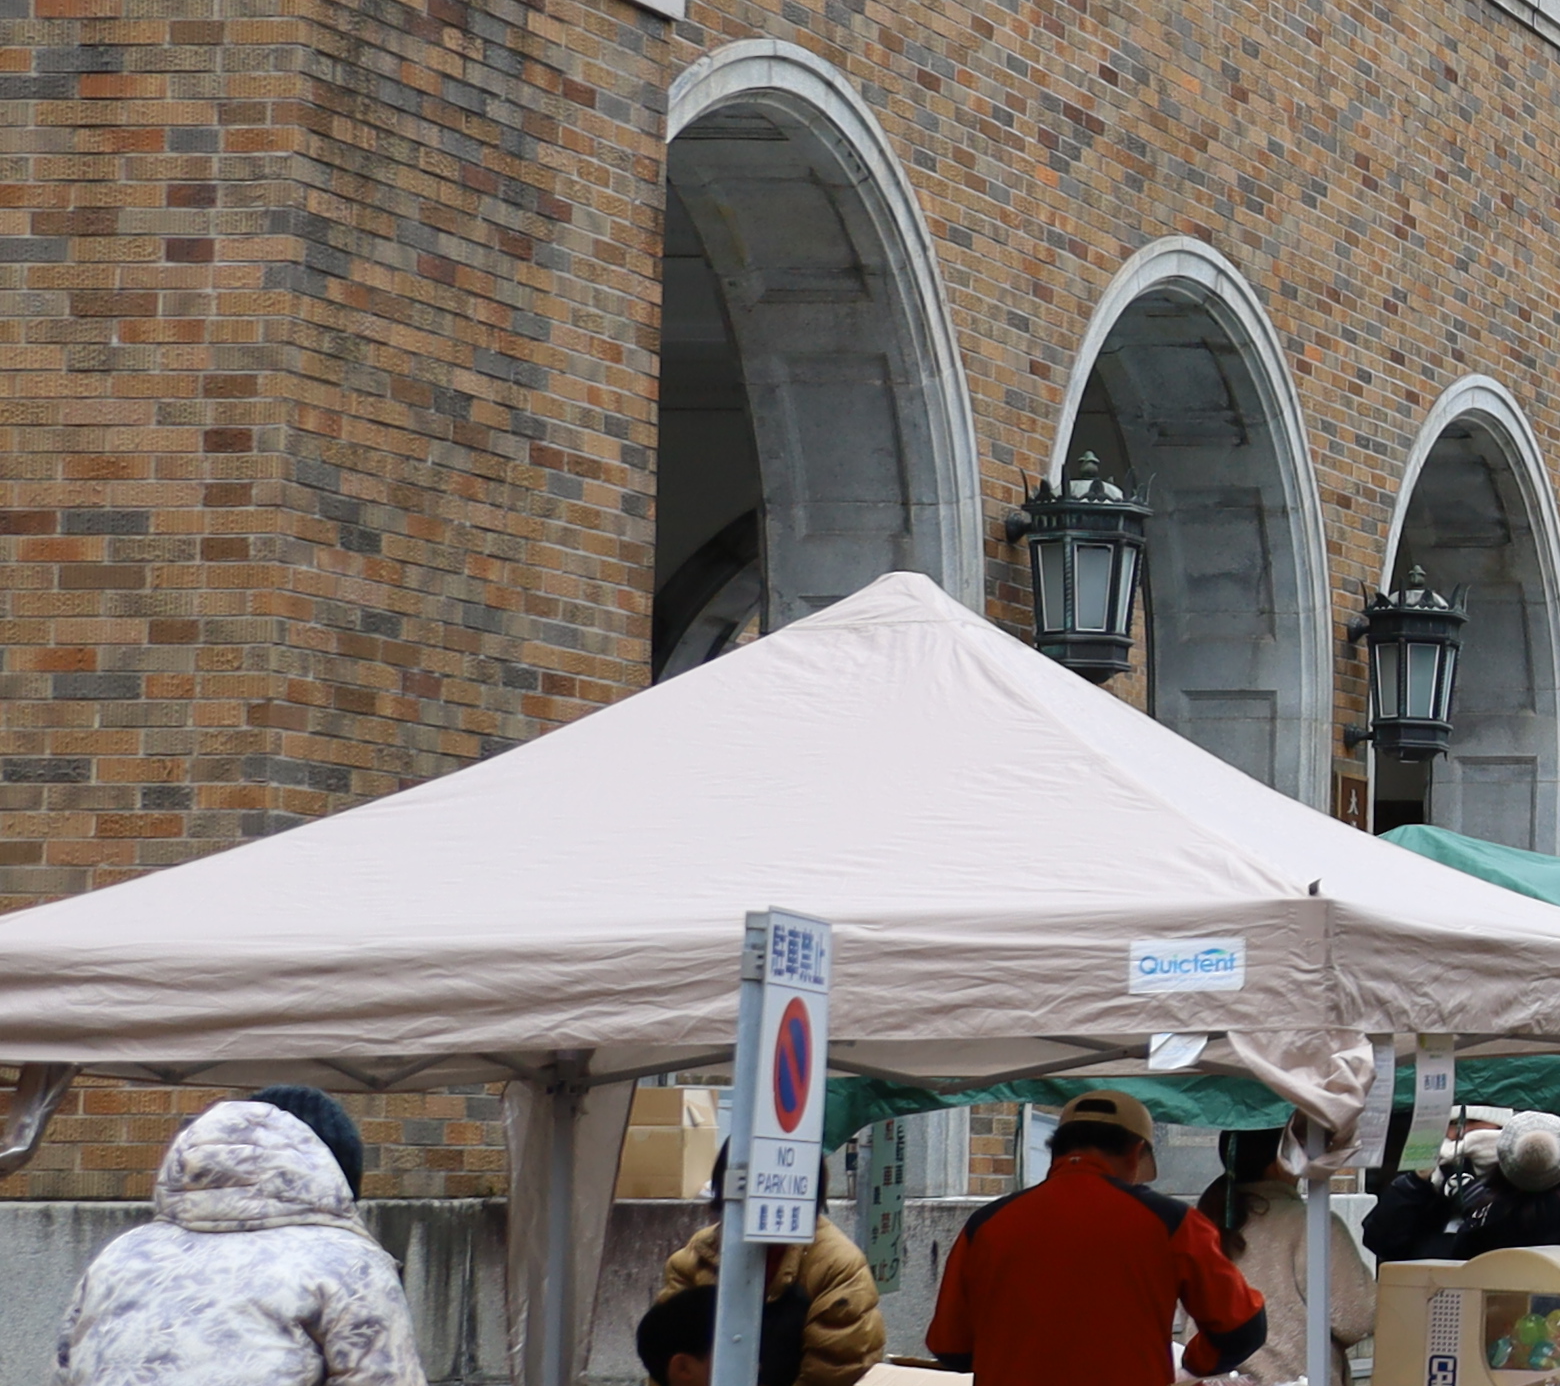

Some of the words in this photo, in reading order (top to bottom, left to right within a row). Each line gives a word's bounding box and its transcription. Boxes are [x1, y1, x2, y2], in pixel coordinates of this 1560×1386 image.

[772, 924, 826, 985] 駐車禁止
[1139, 951, 1237, 975] Quictent
[777, 1146, 795, 1167] NO
[757, 1173, 808, 1196] PARKING
[759, 1204, 801, 1232] 農学部
